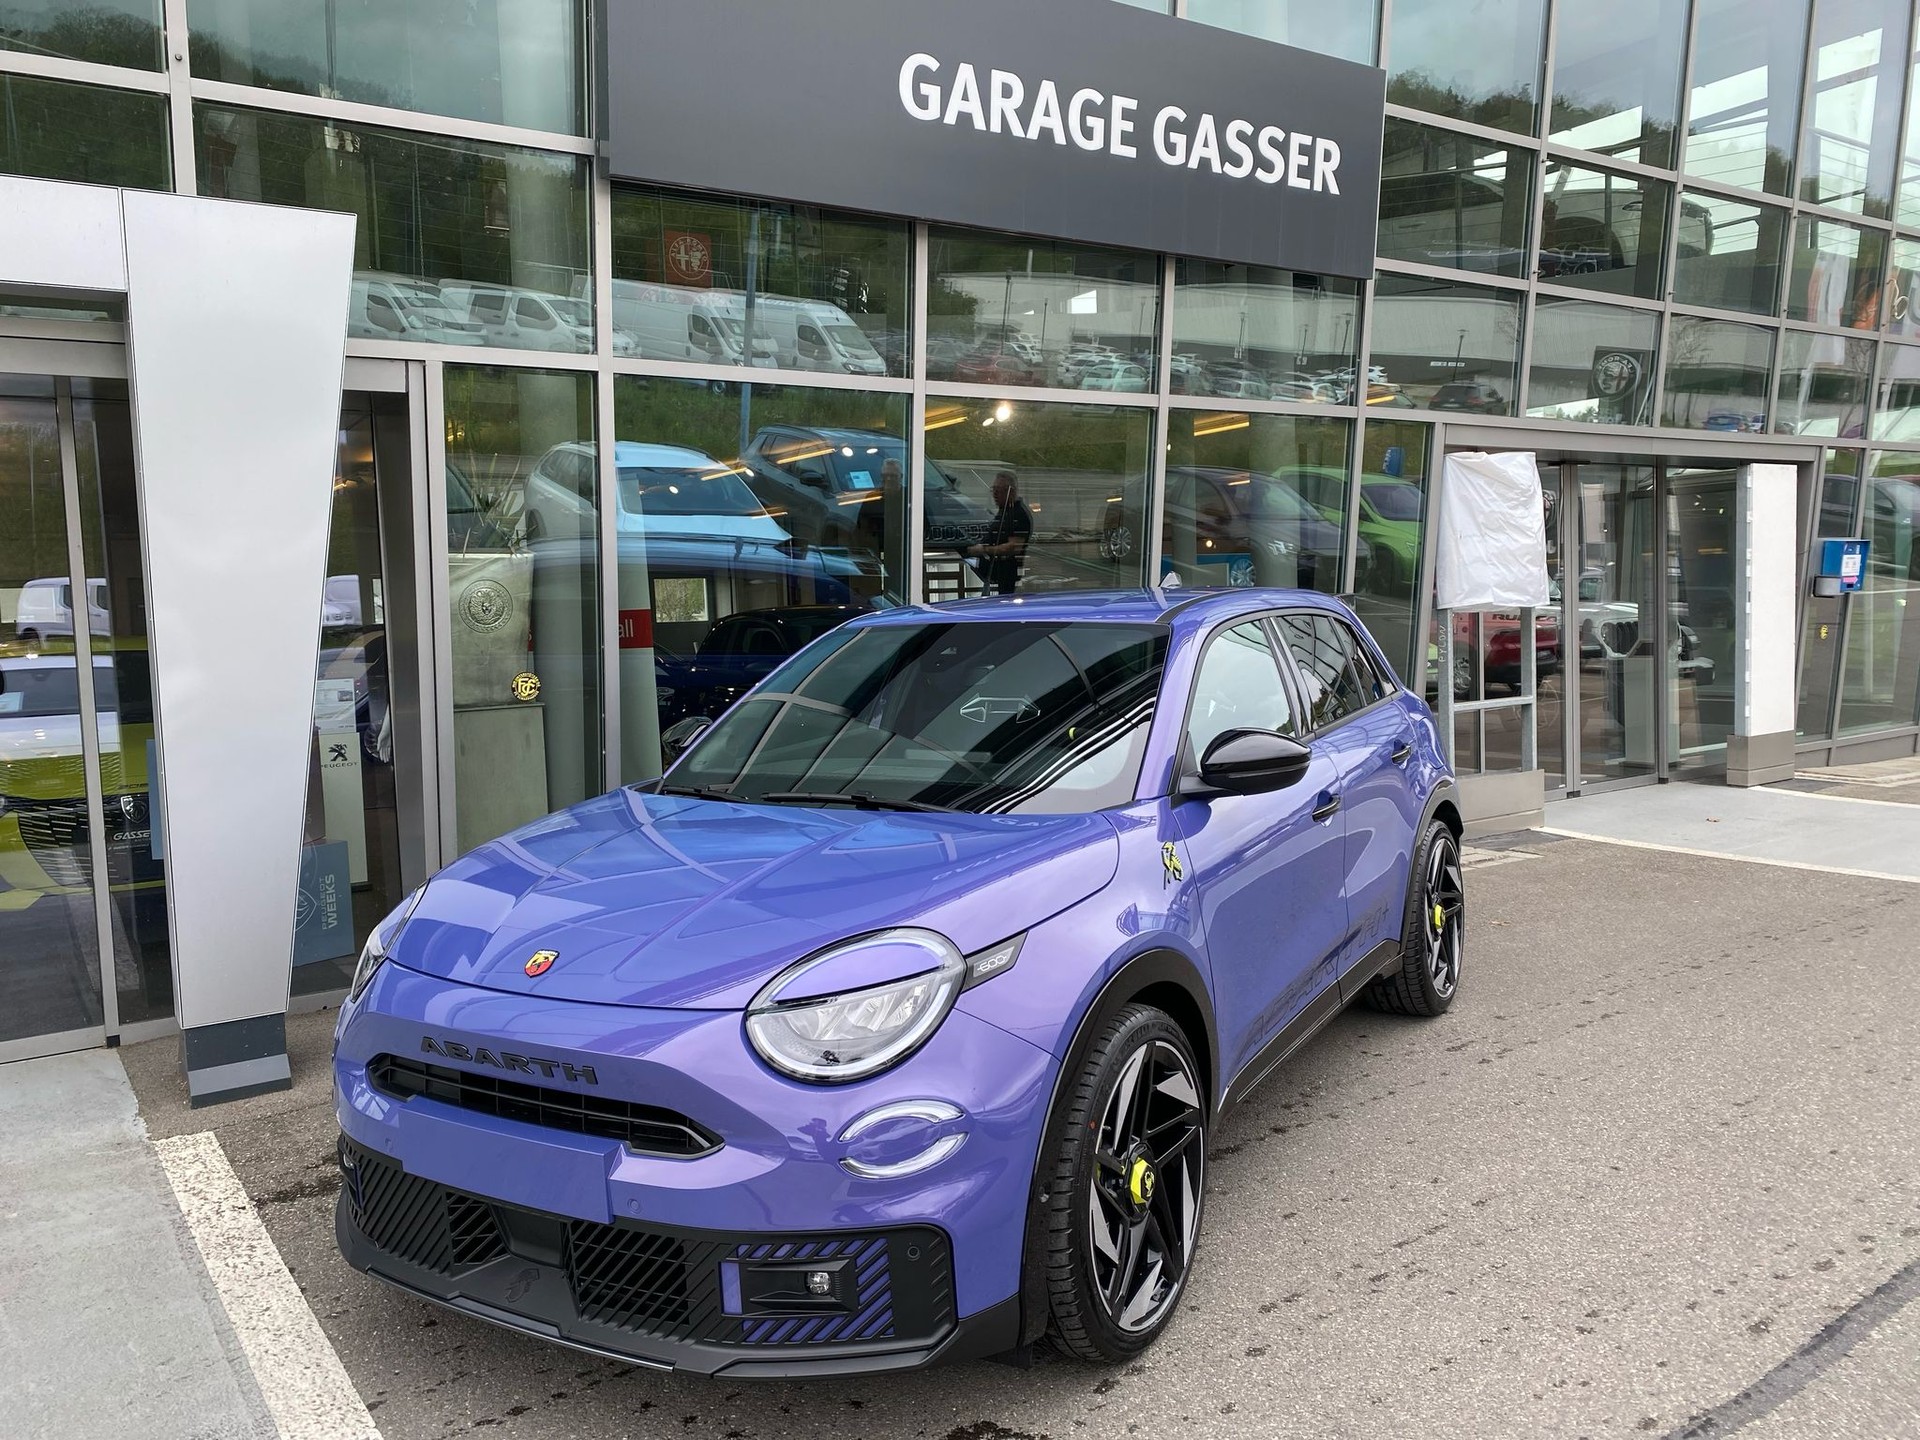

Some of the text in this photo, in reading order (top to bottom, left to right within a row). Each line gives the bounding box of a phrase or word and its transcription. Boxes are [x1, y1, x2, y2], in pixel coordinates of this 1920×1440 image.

[898, 52, 1341, 195] GARAGE GASSER
[113, 829, 151, 841] GASSE
[320, 877, 328, 930] PEUGEOT
[325, 874, 339, 929] WEEKS
[420, 1036, 598, 1085] ABARTH
